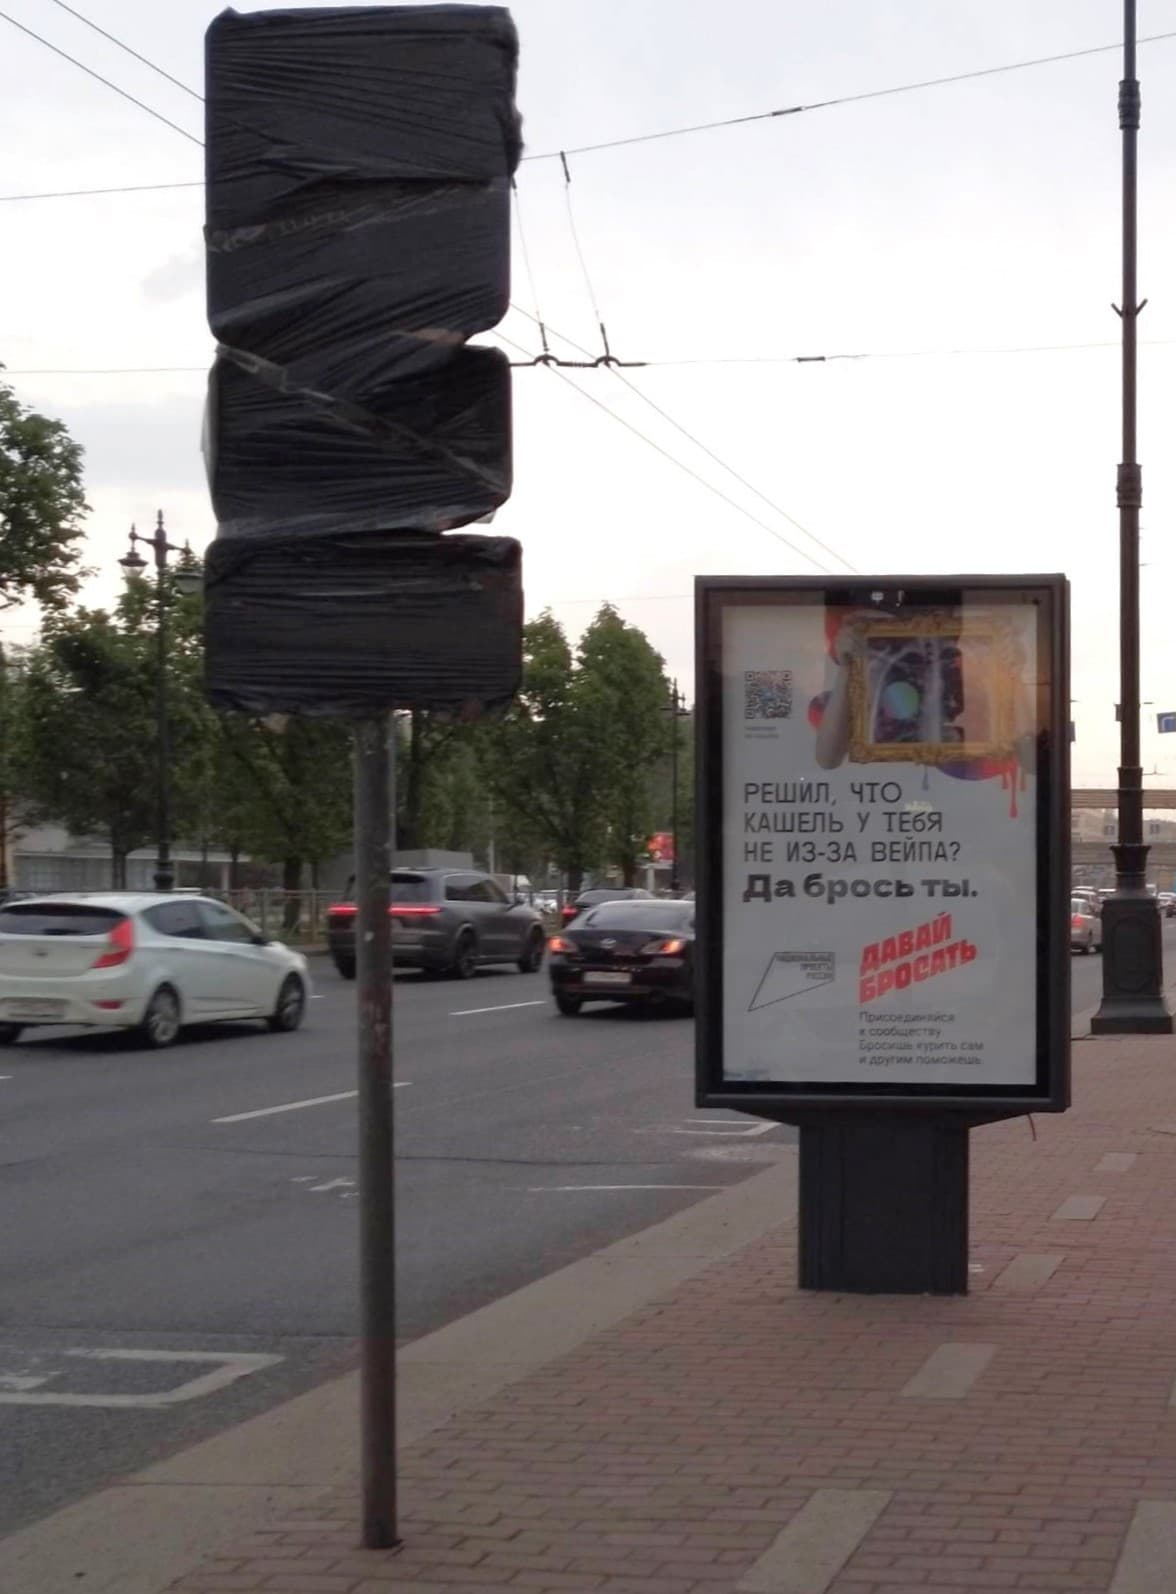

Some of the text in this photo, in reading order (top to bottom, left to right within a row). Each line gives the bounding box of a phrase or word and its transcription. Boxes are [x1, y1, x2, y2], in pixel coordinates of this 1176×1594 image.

[744, 782, 902, 806] РЕШИЛ, ЧТО
[744, 811, 844, 833] КАШЕЛЬ
[857, 811, 870, 833] У
[744, 836, 961, 862] НЕ ИЗ-ЗА ВЕЙПА?
[743, 873, 978, 904] Да брось ты.
[860, 911, 953, 974] ДАВАЙ
[859, 939, 978, 1004] БРОСАТЬ
